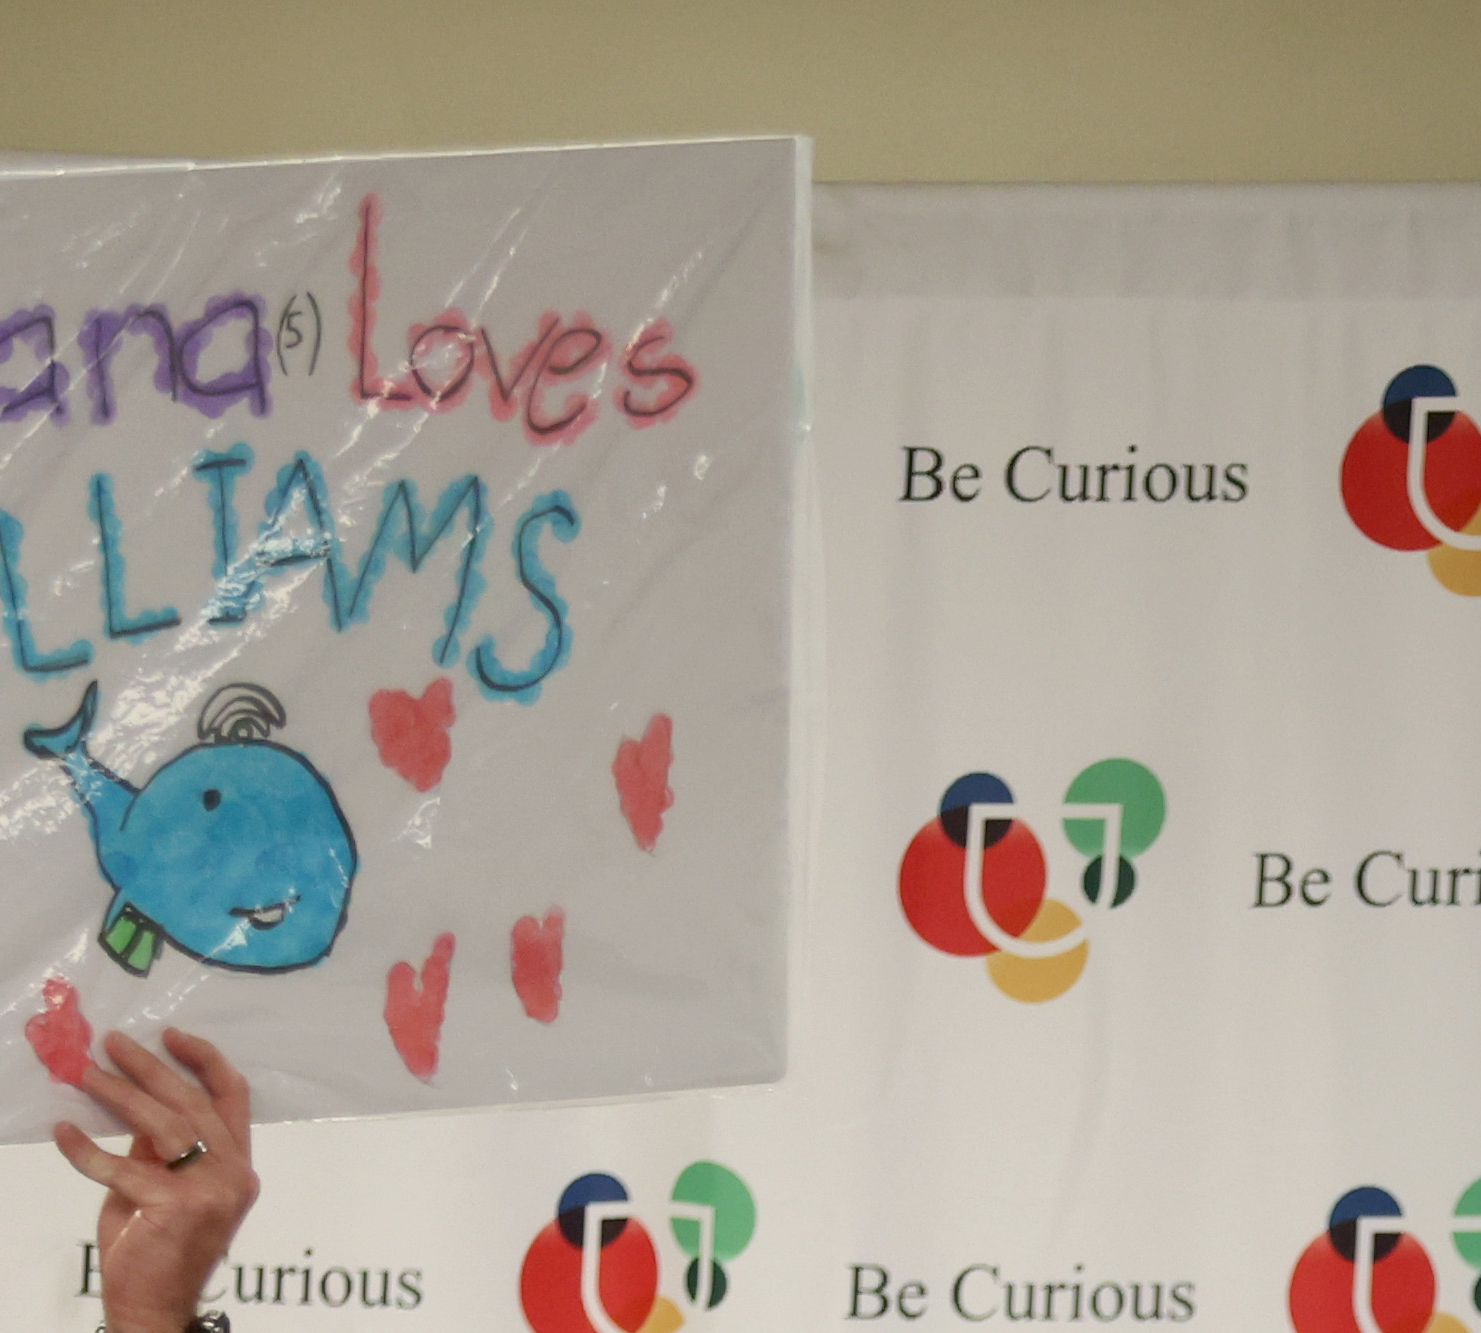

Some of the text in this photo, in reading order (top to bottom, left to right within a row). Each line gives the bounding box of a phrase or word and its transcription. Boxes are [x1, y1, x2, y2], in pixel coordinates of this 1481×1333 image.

[349, 193, 702, 446] Loves
[896, 443, 1250, 505] Be Curious
[1250, 851, 1334, 910] Be
[209, 1247, 424, 1310] urious
[843, 1262, 1197, 1324] Be Curious
